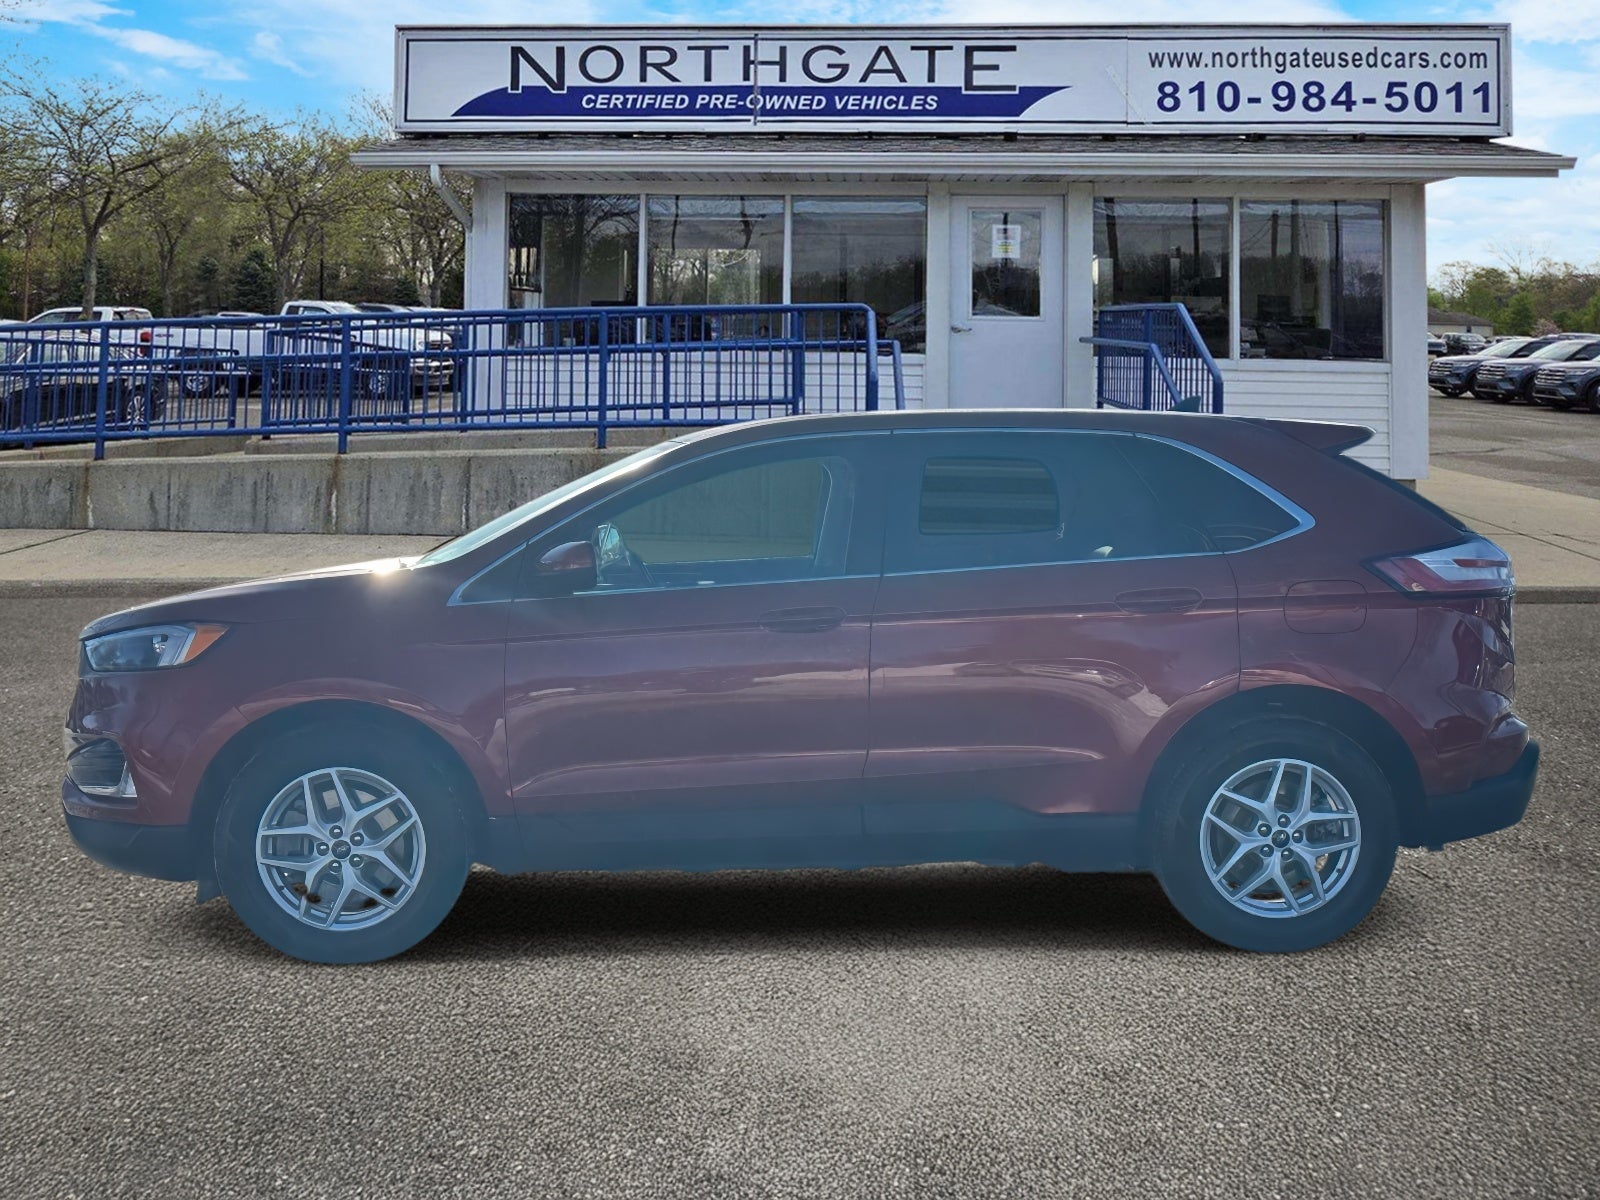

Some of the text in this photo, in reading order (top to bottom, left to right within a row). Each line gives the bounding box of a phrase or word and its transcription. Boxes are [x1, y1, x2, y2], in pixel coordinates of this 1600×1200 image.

[509, 45, 1017, 93] NORTHGATE
[1148, 46, 1488, 73] www.northgateusedcars.com
[581, 94, 939, 111] CERTIFIED PRE-OWNED VEHICLES
[1156, 81, 1491, 113] 810-984-5011
